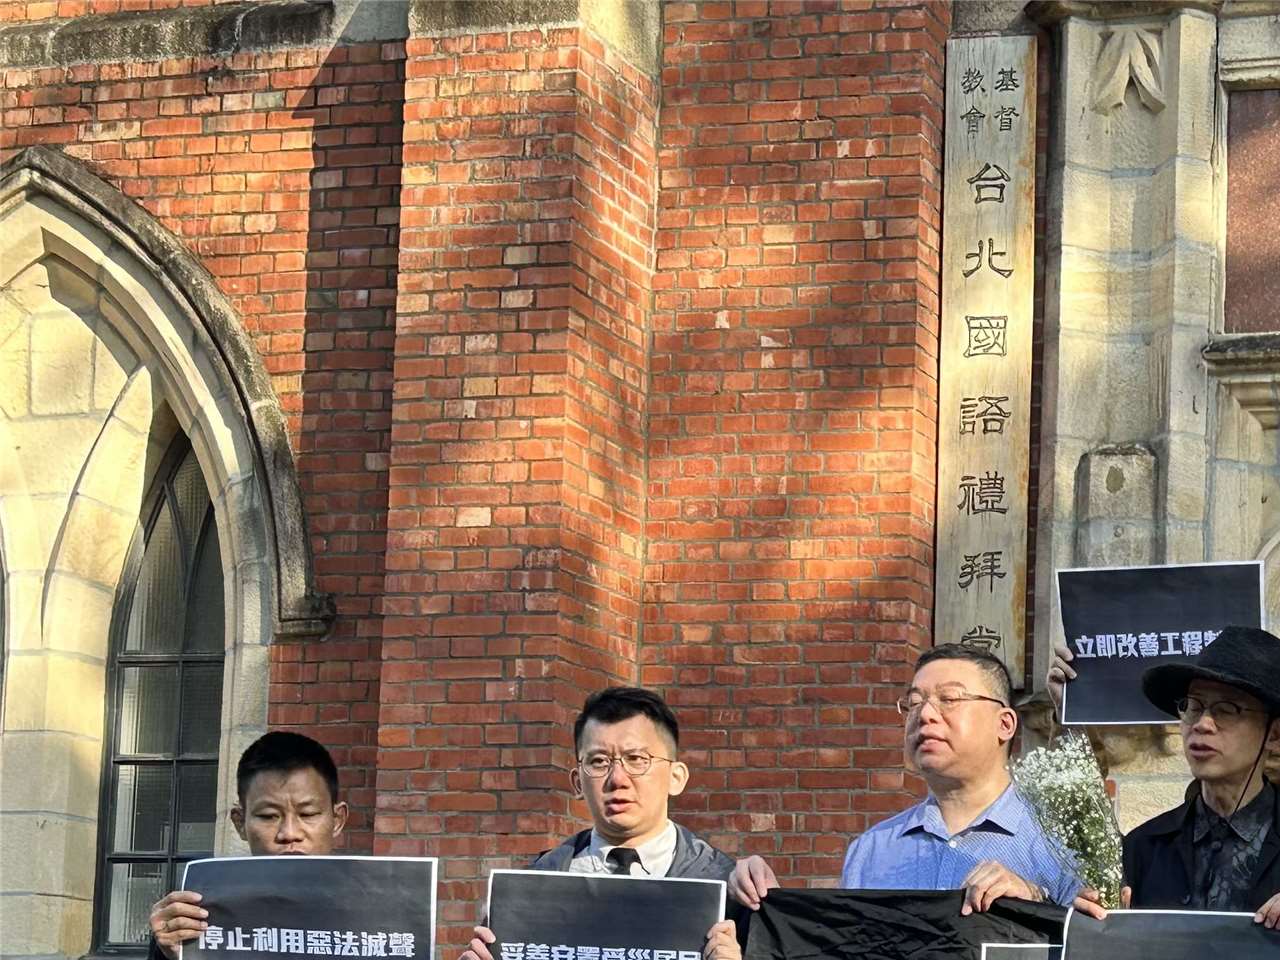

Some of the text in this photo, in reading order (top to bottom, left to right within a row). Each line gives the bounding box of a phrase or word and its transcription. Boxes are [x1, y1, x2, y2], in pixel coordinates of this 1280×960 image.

[960, 67, 987, 135] 教會
[994, 67, 1020, 134] 基督
[198, 926, 416, 958] 停止利用惡法滅聲
